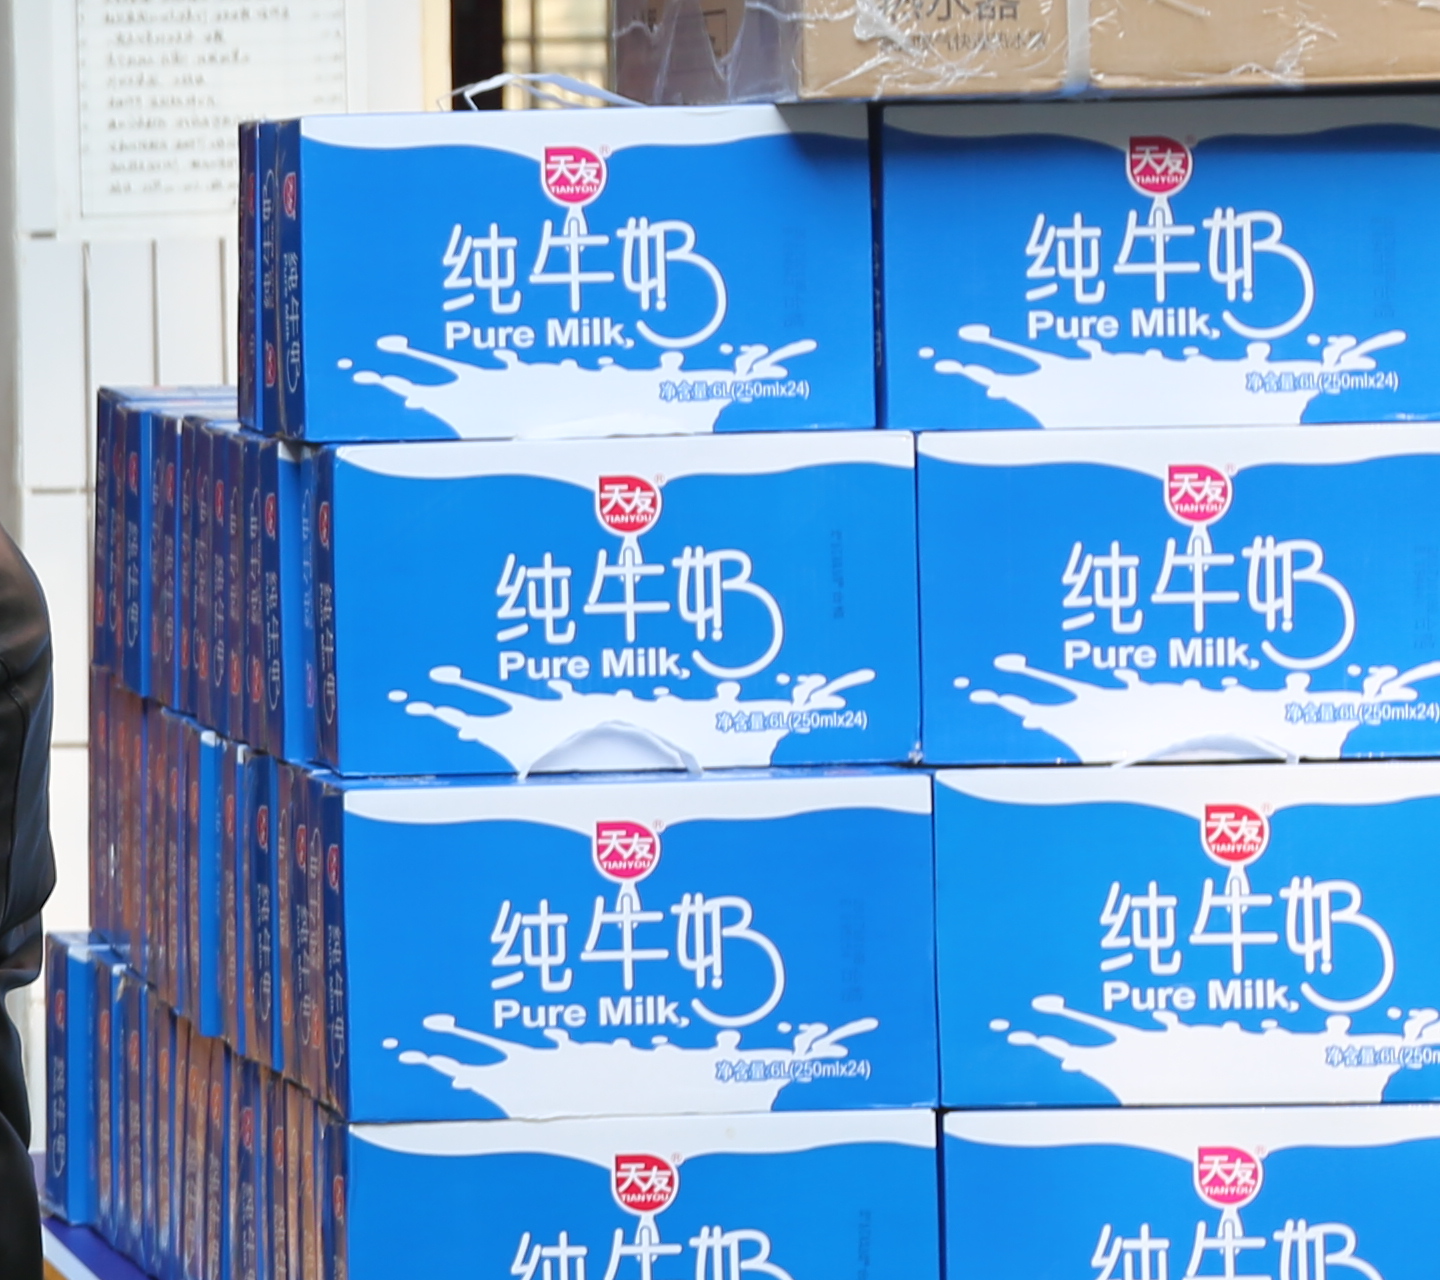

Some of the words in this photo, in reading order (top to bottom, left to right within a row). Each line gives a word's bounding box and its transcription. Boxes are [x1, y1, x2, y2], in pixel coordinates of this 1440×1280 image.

[546, 155, 600, 185] 天友
[1131, 145, 1186, 175] 天友
[443, 217, 727, 348] 纯牛奶
[1025, 207, 1314, 339] 纯牛奶
[445, 322, 535, 349] Pure
[1027, 310, 1119, 340] Pure
[599, 484, 654, 514] 天友
[1170, 473, 1225, 503] 天友
[496, 546, 783, 678] 纯牛奶
[1061, 536, 1355, 669] 纯牛奶
[499, 651, 591, 680] Pure
[1064, 640, 1157, 669] Pure
[1206, 812, 1261, 843] 天友
[599, 829, 653, 860] 天友
[1100, 876, 1395, 1012] 纯牛奶
[490, 893, 785, 1027] 纯牛奶
[1103, 981, 1197, 1011] Pure
[493, 999, 587, 1028] Pure
[617, 1163, 672, 1195] 天友
[1200, 1155, 1256, 1186] 天友
